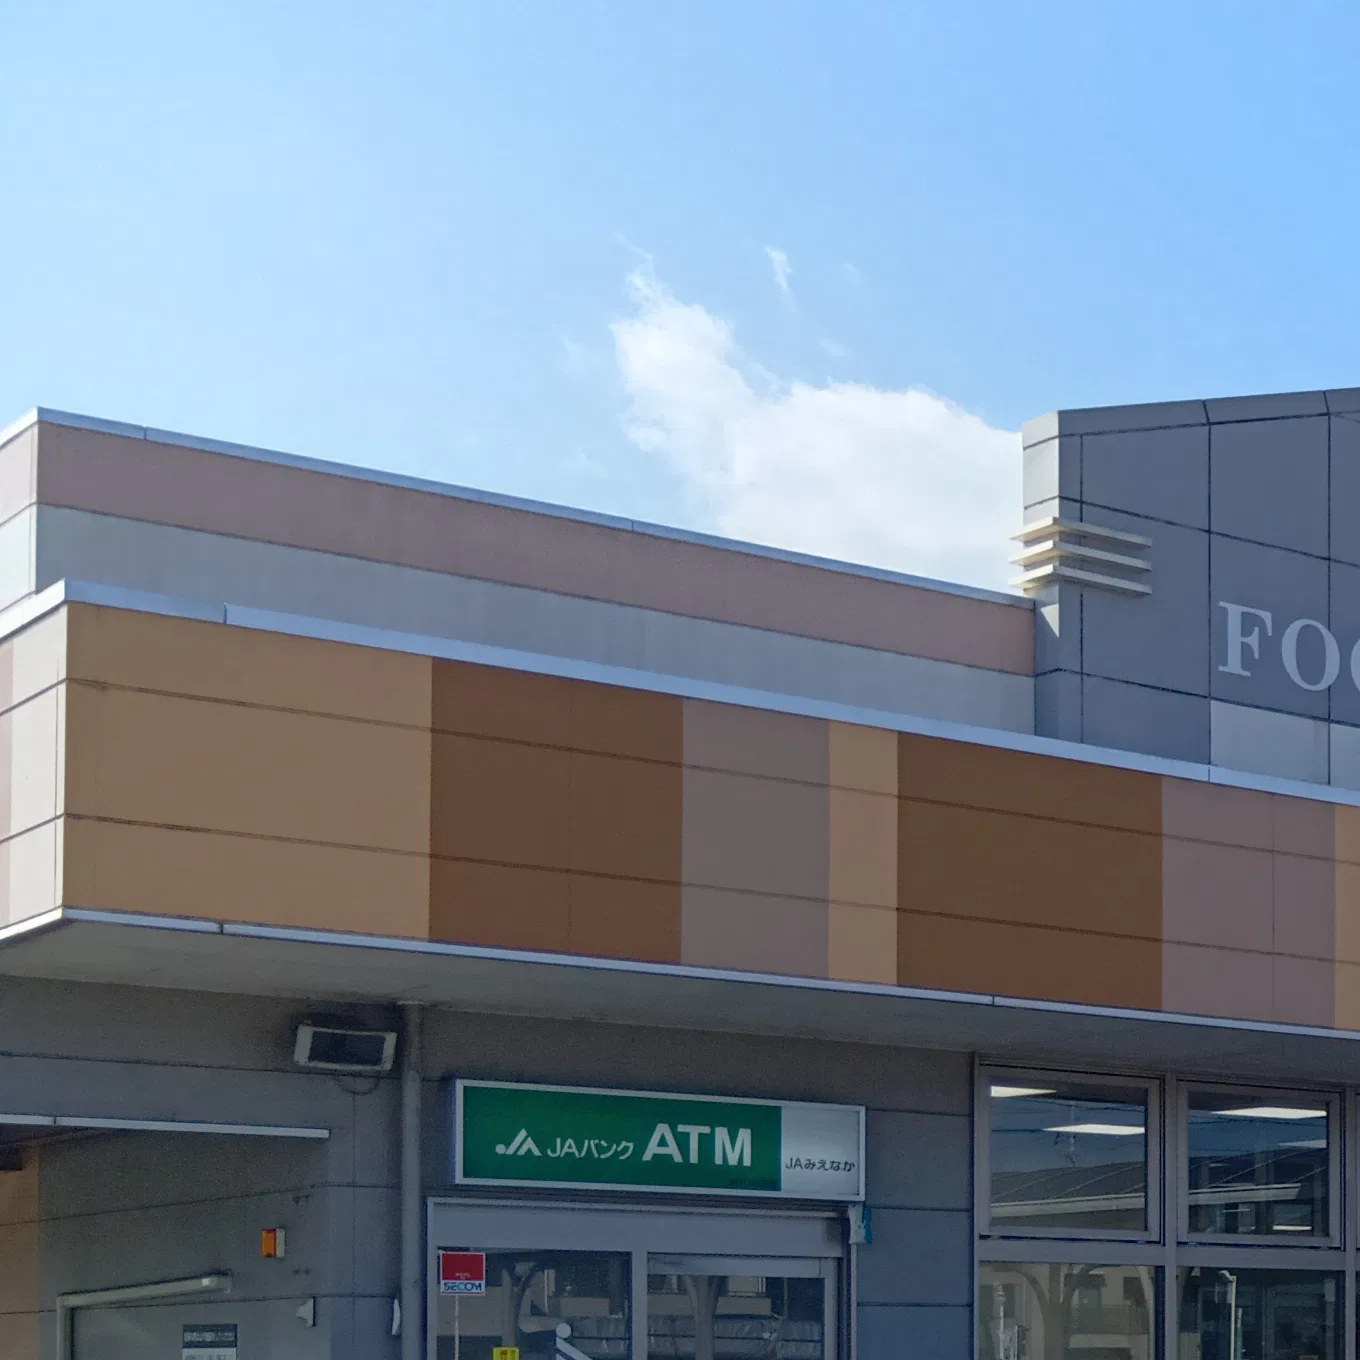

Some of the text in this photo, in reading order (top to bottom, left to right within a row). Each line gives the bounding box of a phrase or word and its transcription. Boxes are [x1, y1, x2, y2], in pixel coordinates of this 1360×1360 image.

[547, 1123, 752, 1167] JAバンク ATM
[785, 1156, 856, 1173] JAみえなか
[443, 1282, 483, 1292] SECOM
